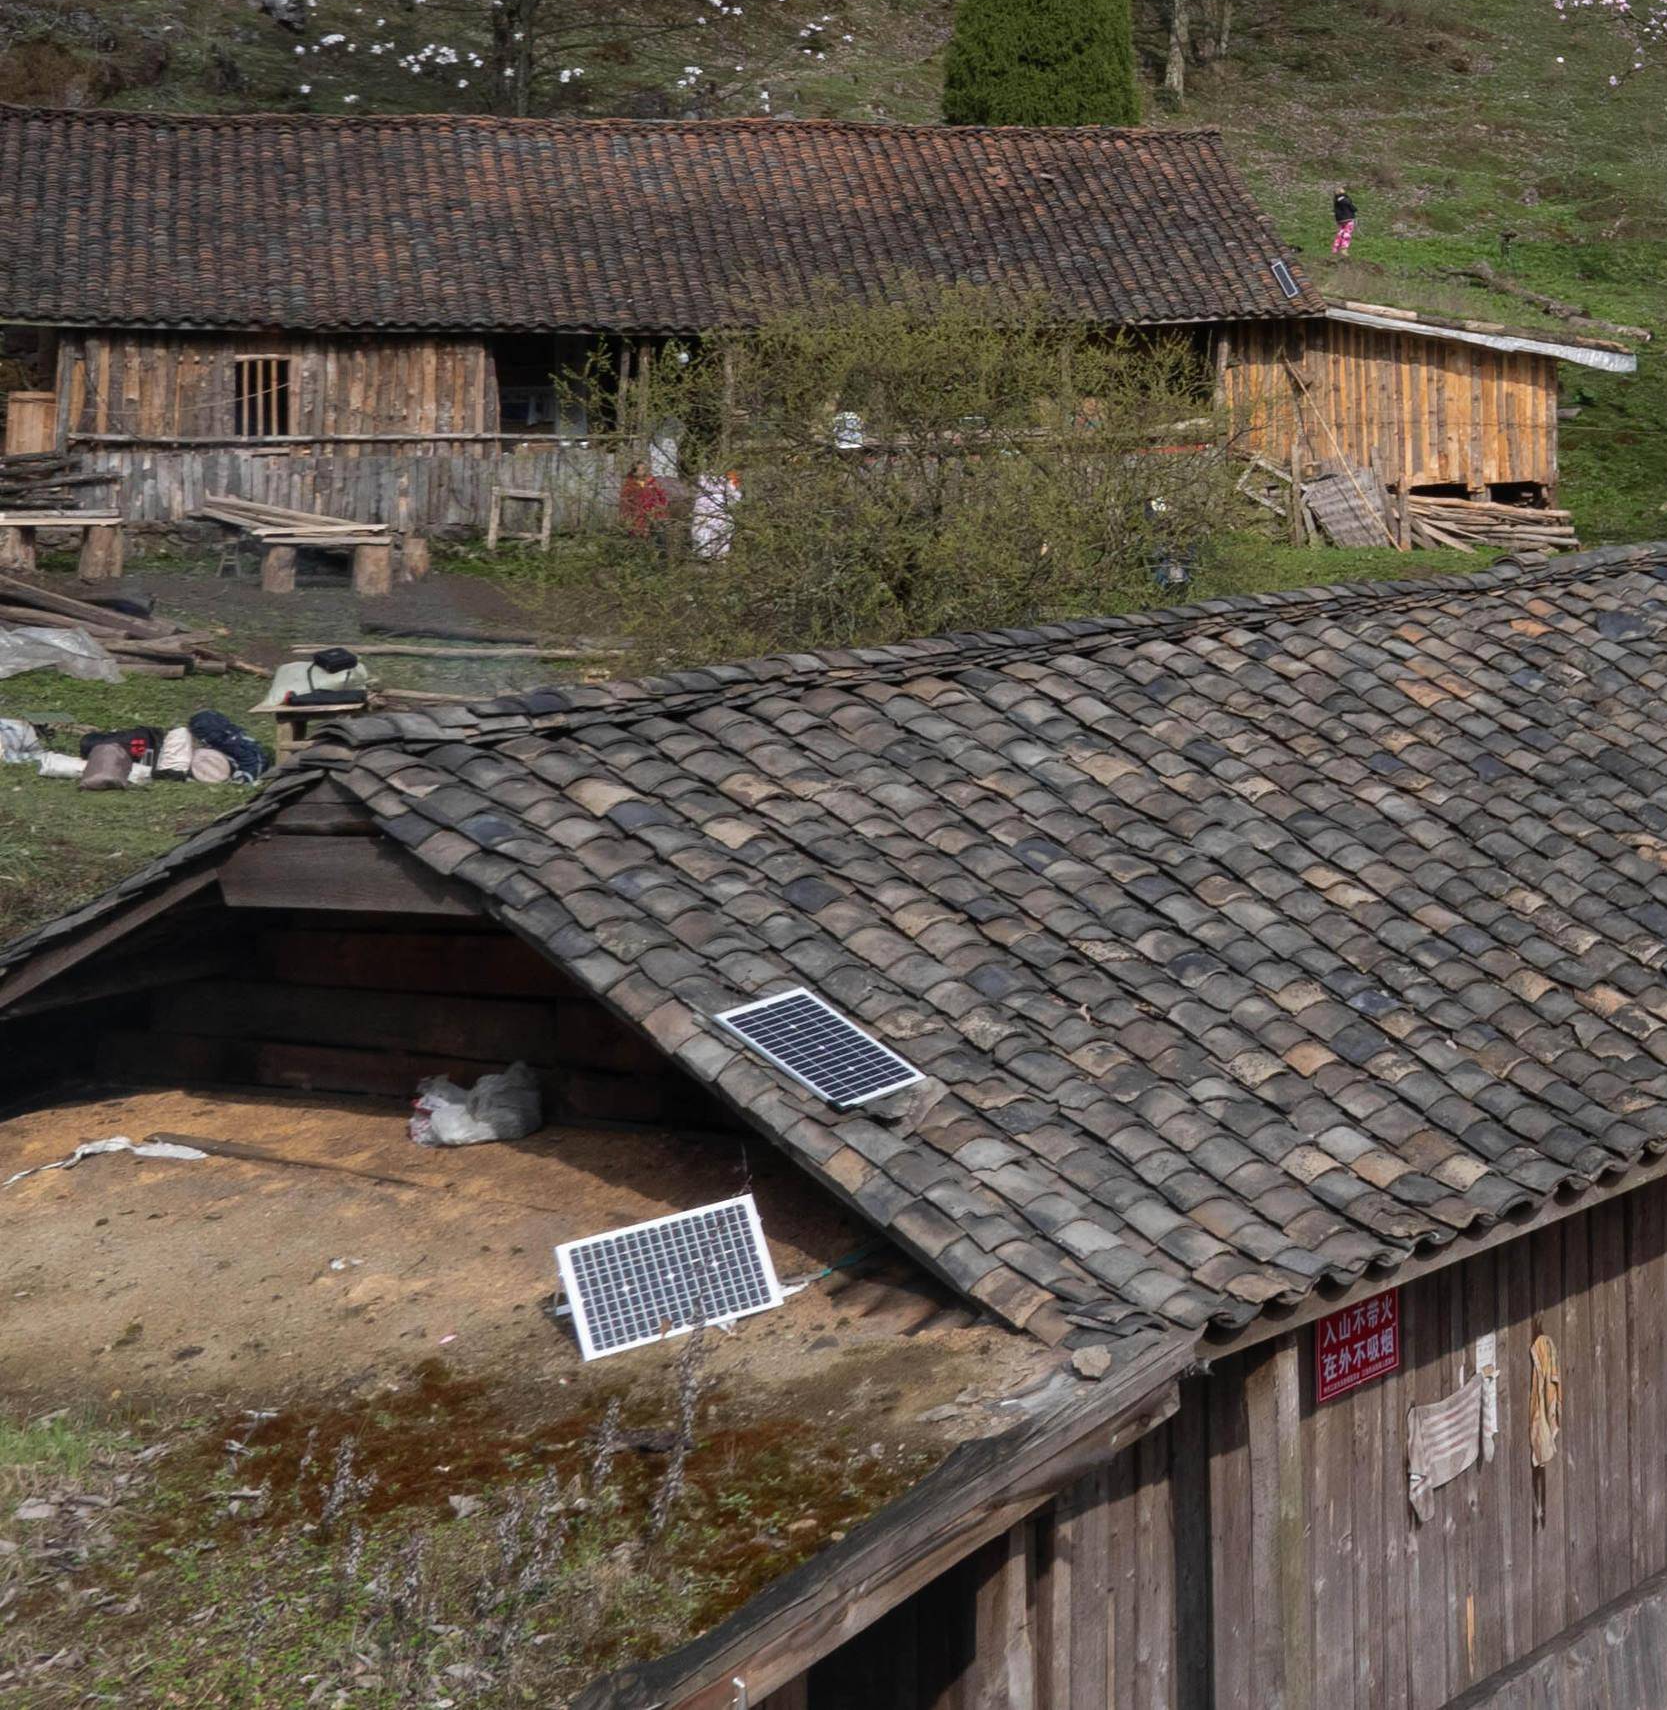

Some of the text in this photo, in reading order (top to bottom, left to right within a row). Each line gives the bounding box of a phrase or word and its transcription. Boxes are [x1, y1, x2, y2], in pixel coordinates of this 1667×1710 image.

[1323, 1295, 1393, 1348] 入山不带火
[1321, 1326, 1394, 1383] 在外不吸烟
